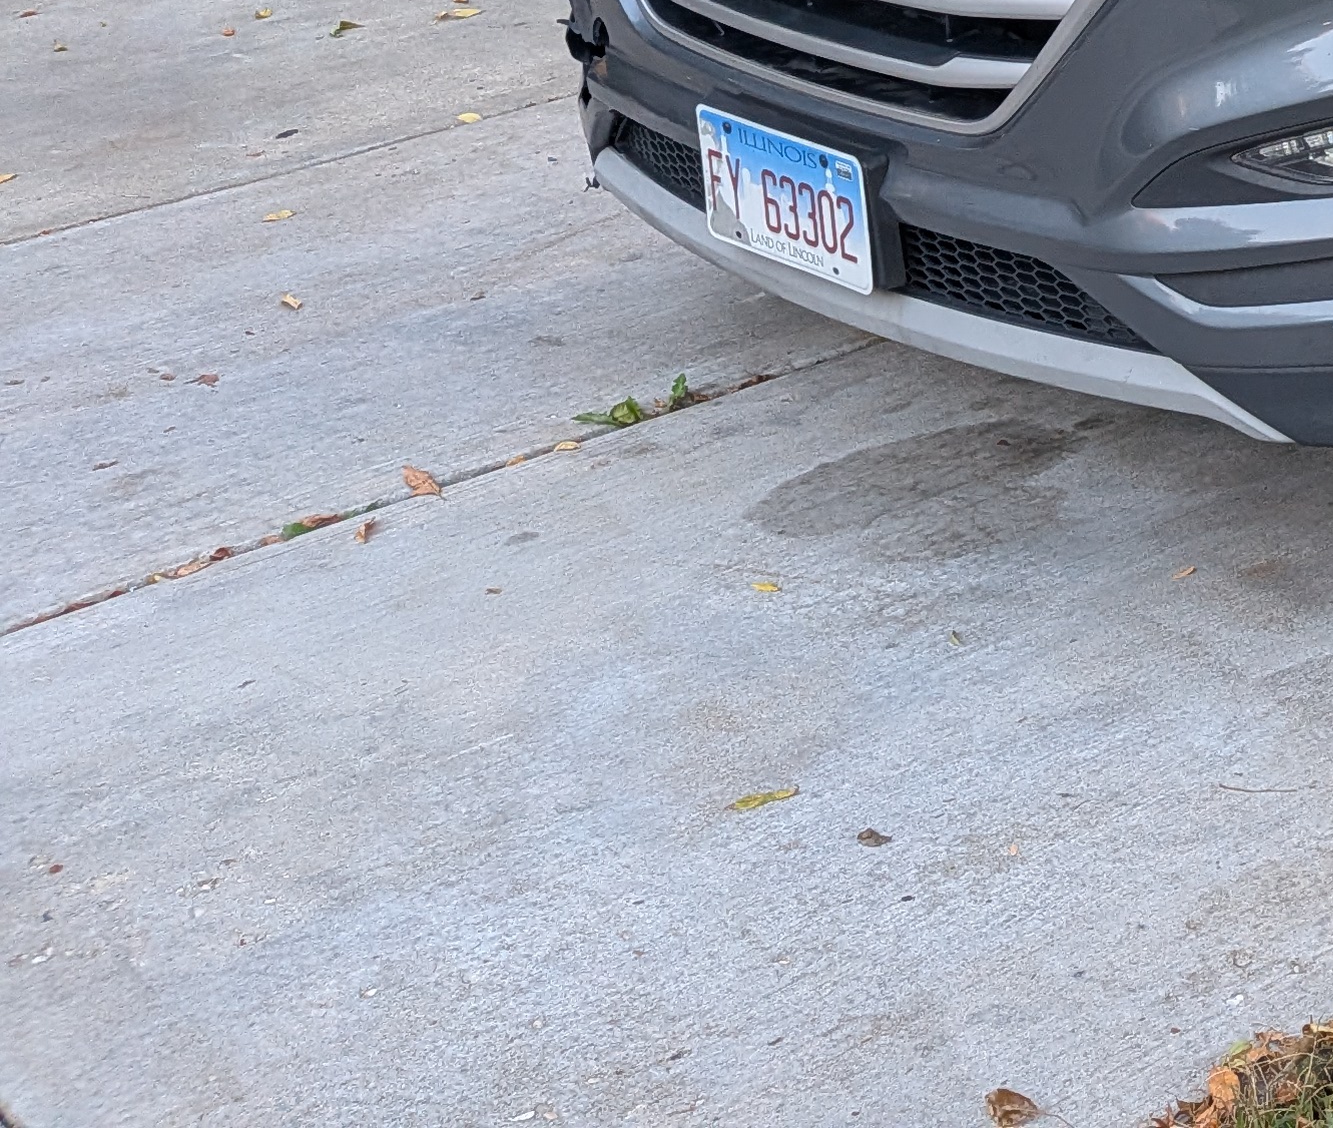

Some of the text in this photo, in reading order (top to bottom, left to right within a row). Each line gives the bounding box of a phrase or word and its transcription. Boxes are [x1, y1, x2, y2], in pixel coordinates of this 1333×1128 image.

[737, 127, 818, 170] ILLINOIS
[707, 148, 859, 264] FY 63302
[750, 227, 774, 249] LAND
[787, 241, 825, 268] LINCOLN
